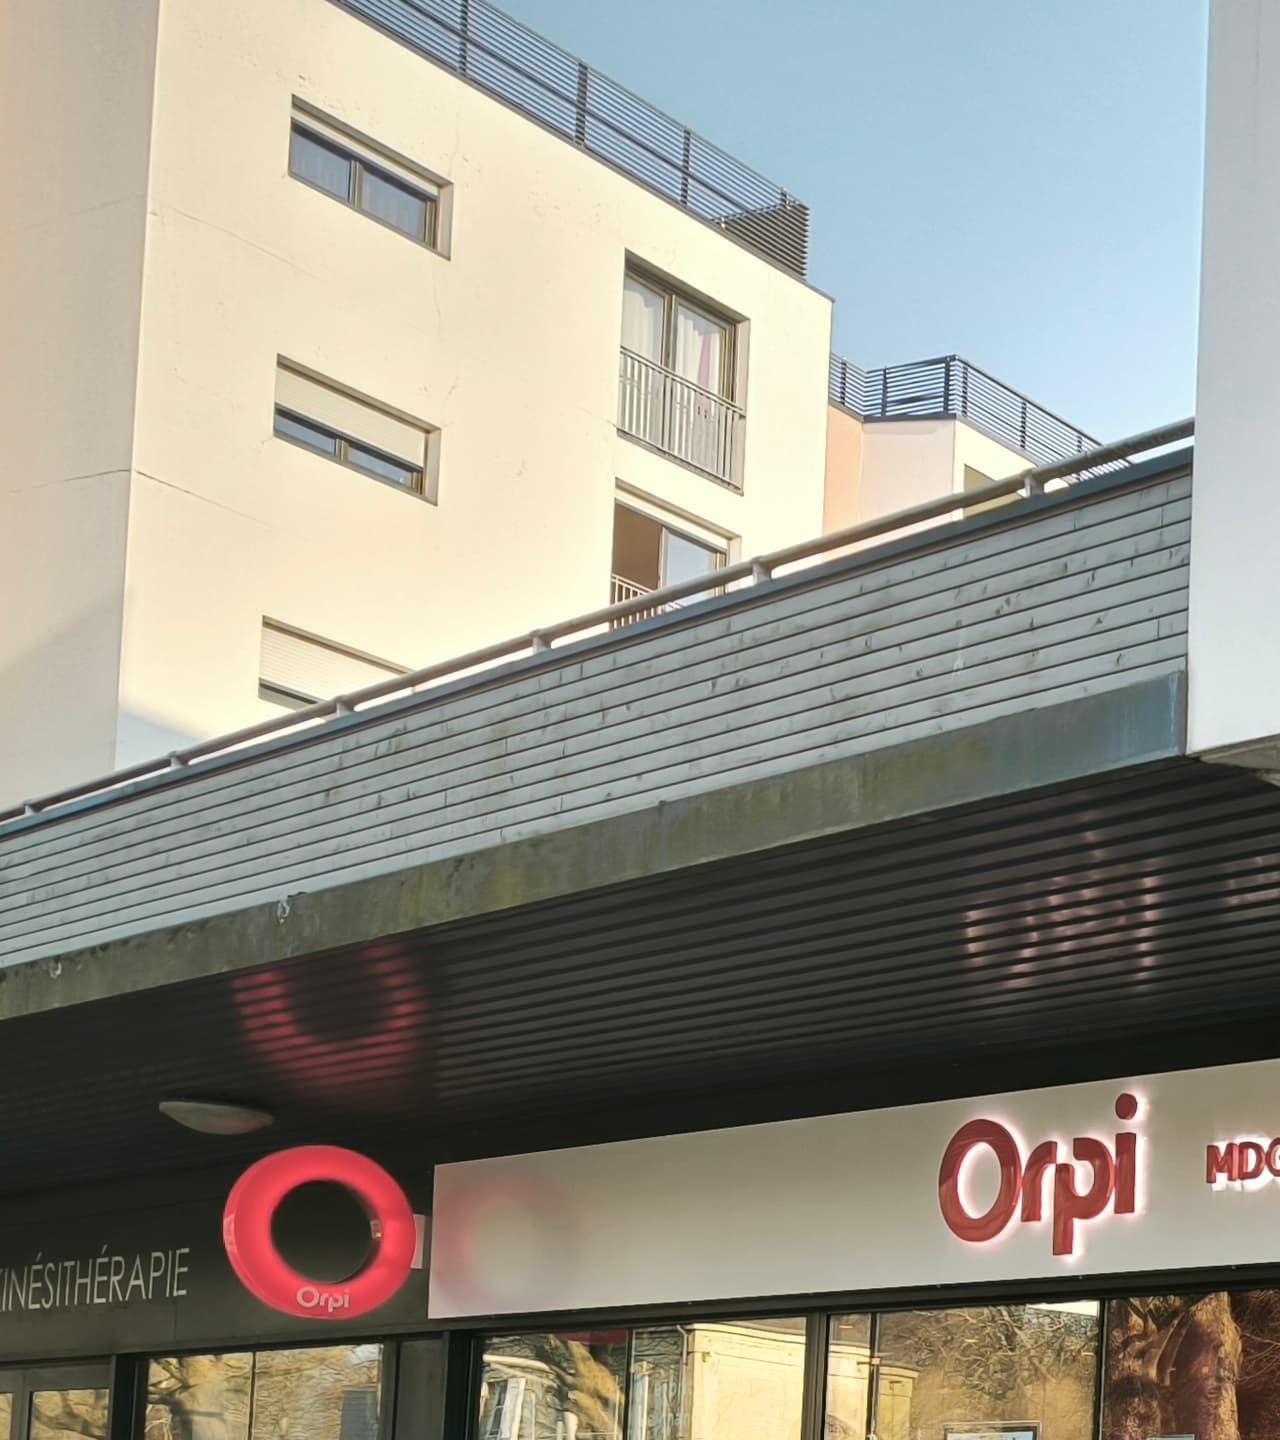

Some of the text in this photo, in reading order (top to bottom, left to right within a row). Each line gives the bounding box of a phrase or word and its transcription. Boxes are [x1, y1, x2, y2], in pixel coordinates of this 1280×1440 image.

[938, 1093, 1138, 1256] Orpi
[0, 1244, 190, 1313] INÉSITHÉRAPIE
[296, 1286, 350, 1312] Orpi
